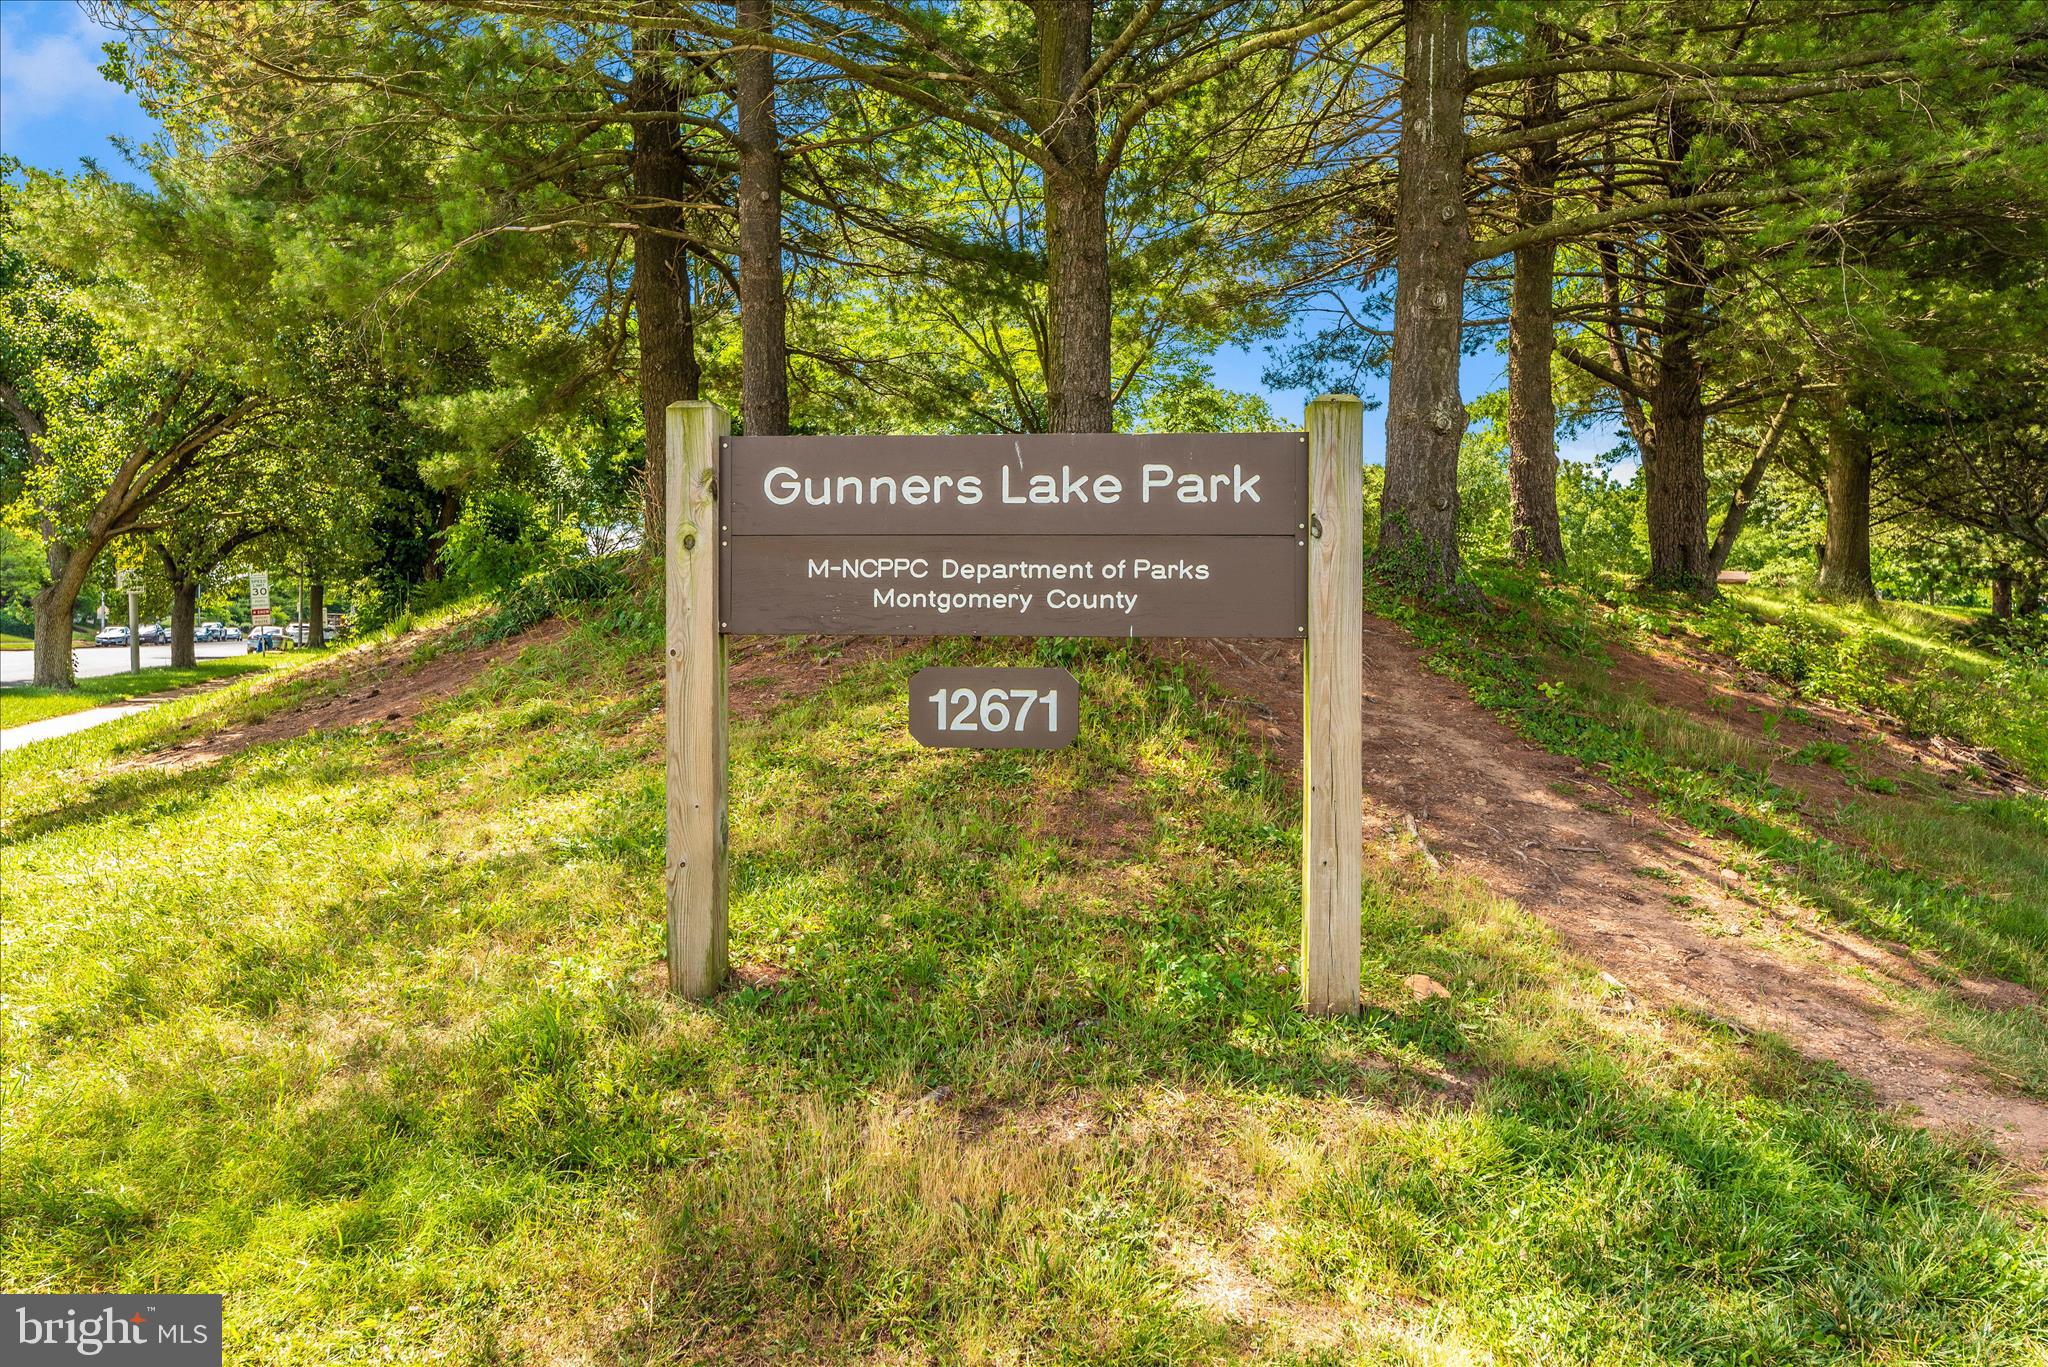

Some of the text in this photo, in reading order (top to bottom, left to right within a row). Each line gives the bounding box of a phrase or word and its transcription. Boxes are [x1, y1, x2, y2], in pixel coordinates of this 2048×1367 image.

[763, 463, 1261, 505] Gunners Lake Park
[808, 558, 1210, 581] M-NCPPC Department of Parks
[252, 588, 267, 596] 30
[873, 588, 1139, 614] Montgomery County
[928, 688, 1058, 732] 12671
